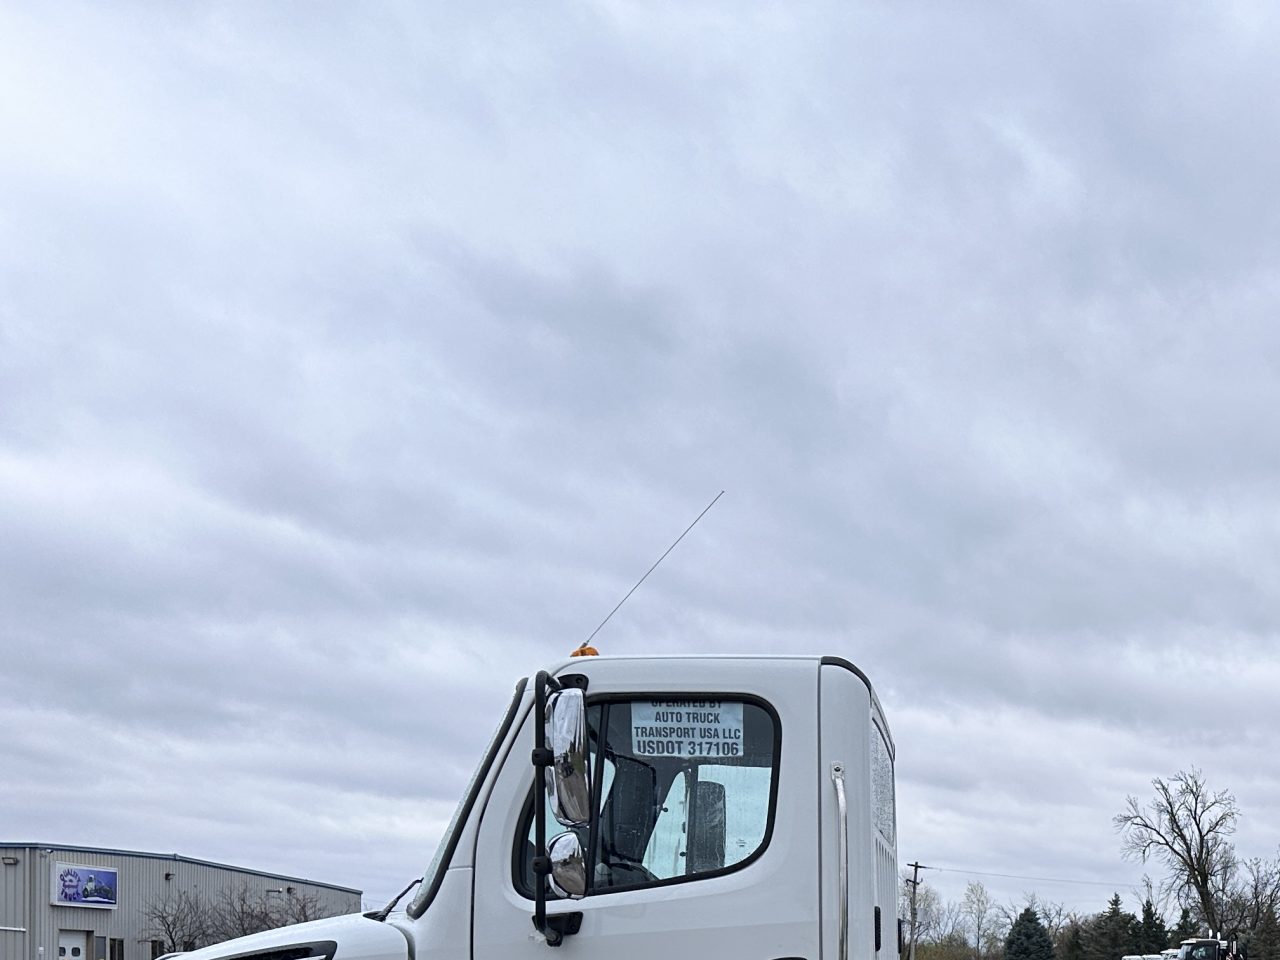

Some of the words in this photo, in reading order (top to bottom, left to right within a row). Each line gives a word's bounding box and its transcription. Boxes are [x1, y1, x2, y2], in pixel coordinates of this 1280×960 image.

[654, 711, 682, 723] AUTO
[685, 712, 720, 724] TRUCK
[634, 726, 696, 739] TRANSPORT
[699, 727, 720, 739] USA
[722, 728, 741, 740] LLC
[637, 740, 684, 755] USDOT
[687, 741, 739, 756] 317106
